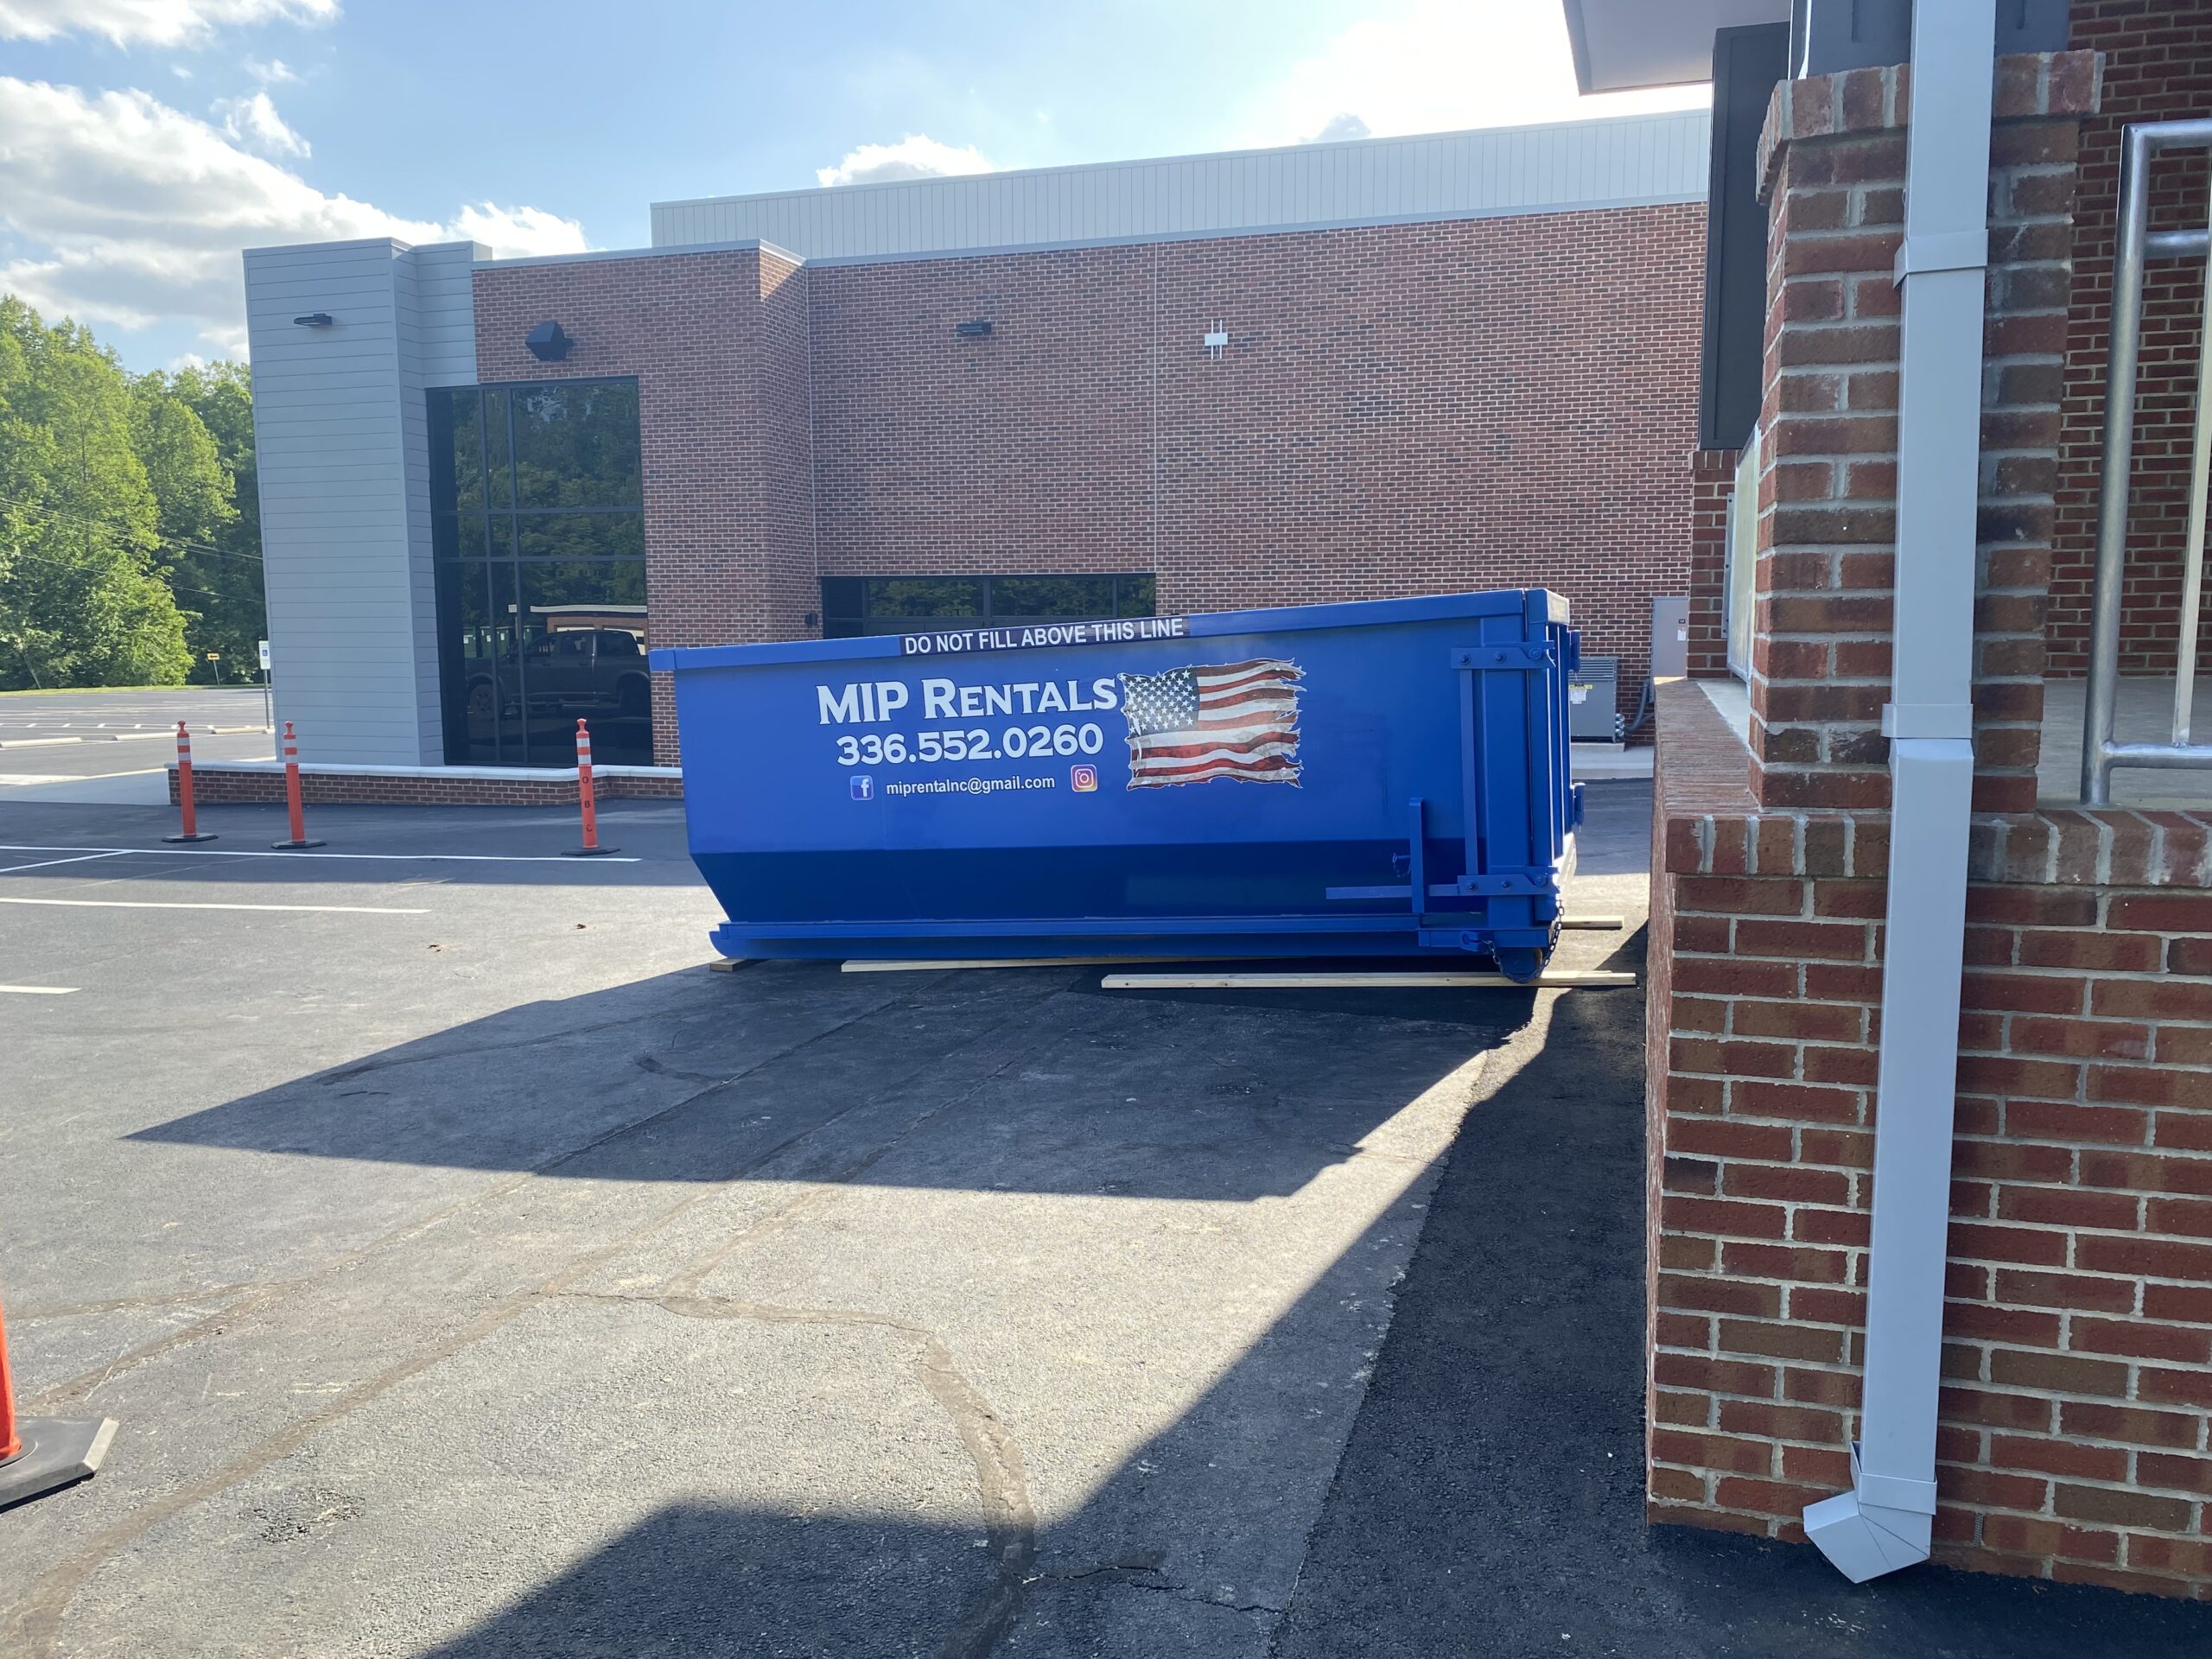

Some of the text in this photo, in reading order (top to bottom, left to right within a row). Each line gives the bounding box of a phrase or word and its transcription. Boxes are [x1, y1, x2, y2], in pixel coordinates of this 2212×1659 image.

[905, 618, 1184, 654] DO NOT FILL ABOVE THIS LINE
[816, 678, 1118, 725] MIP RENTALS
[836, 722, 1104, 766] 336.552.0260
[887, 776, 1055, 798] miprentalnc@gmail.com
